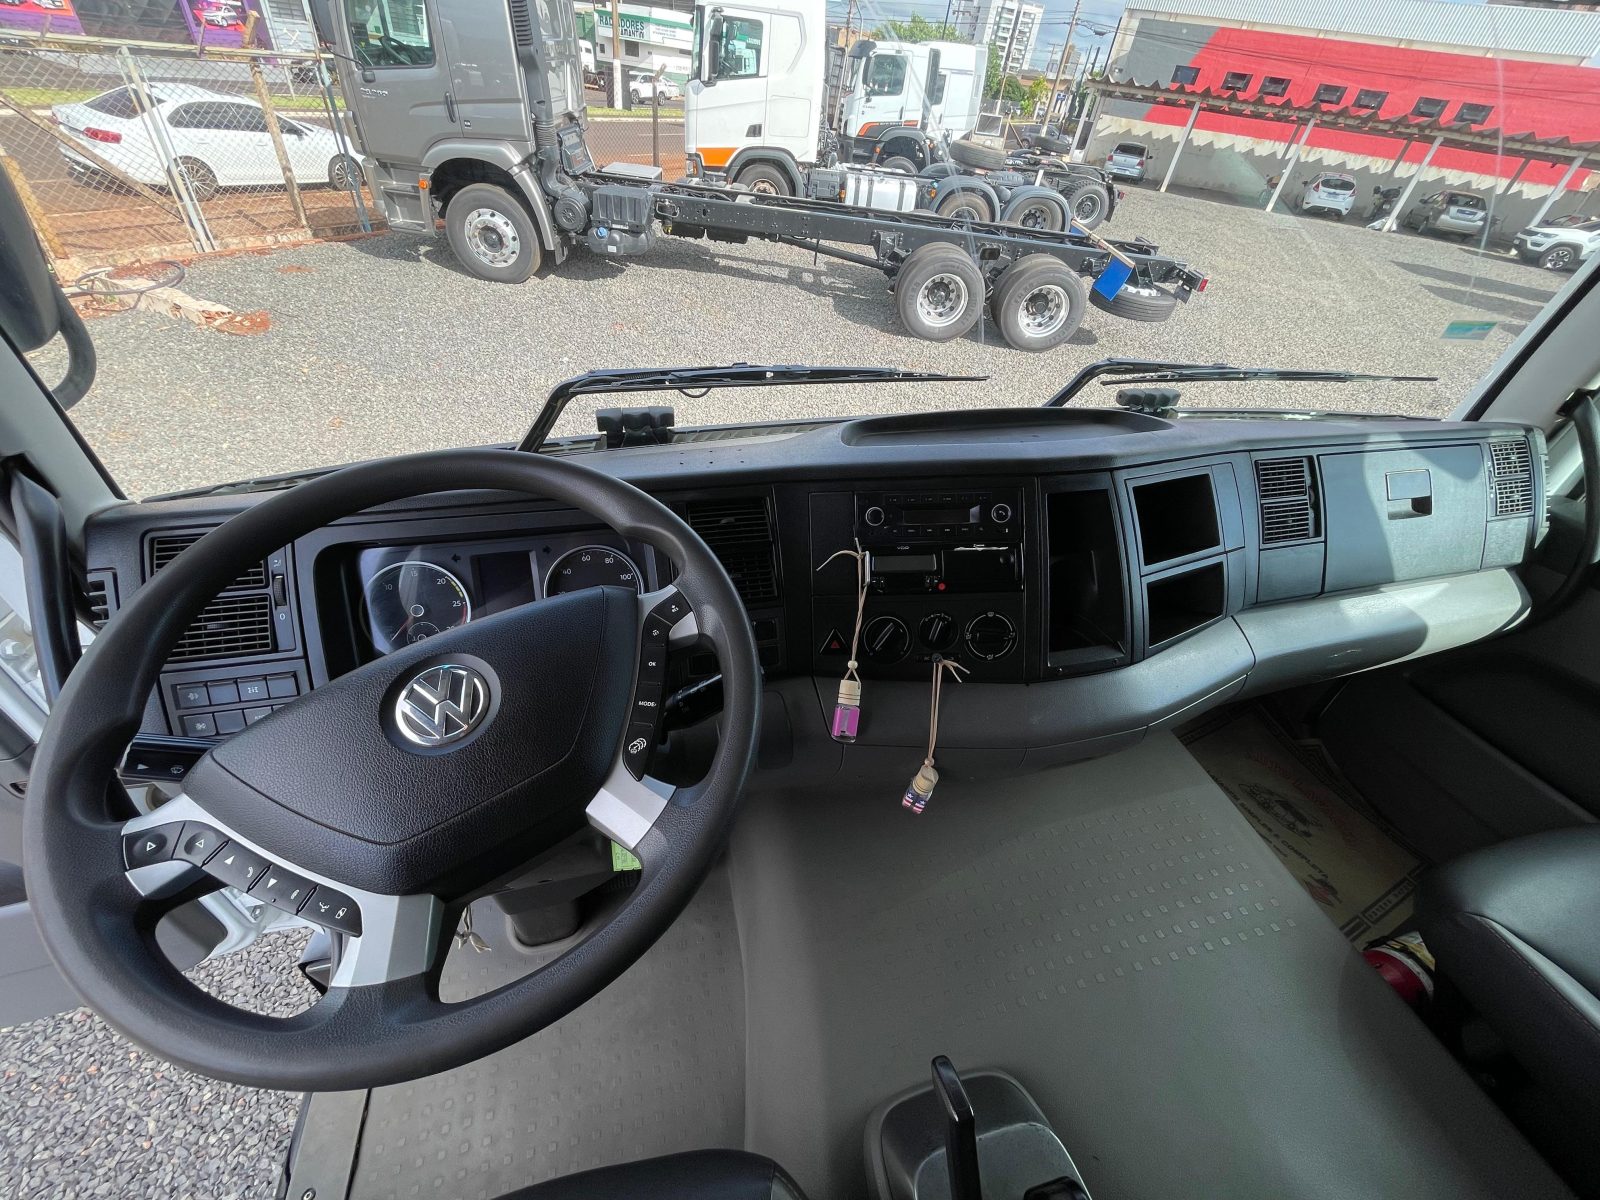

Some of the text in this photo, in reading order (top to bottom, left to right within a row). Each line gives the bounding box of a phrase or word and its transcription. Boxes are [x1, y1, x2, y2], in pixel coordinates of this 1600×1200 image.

[581, 553, 591, 562] 60
[604, 556, 614, 565] 80
[562, 568, 572, 576] 40
[437, 577, 446, 585] 20
[619, 573, 632, 581] 100
[384, 583, 393, 591] 10
[452, 600, 461, 608] 25
